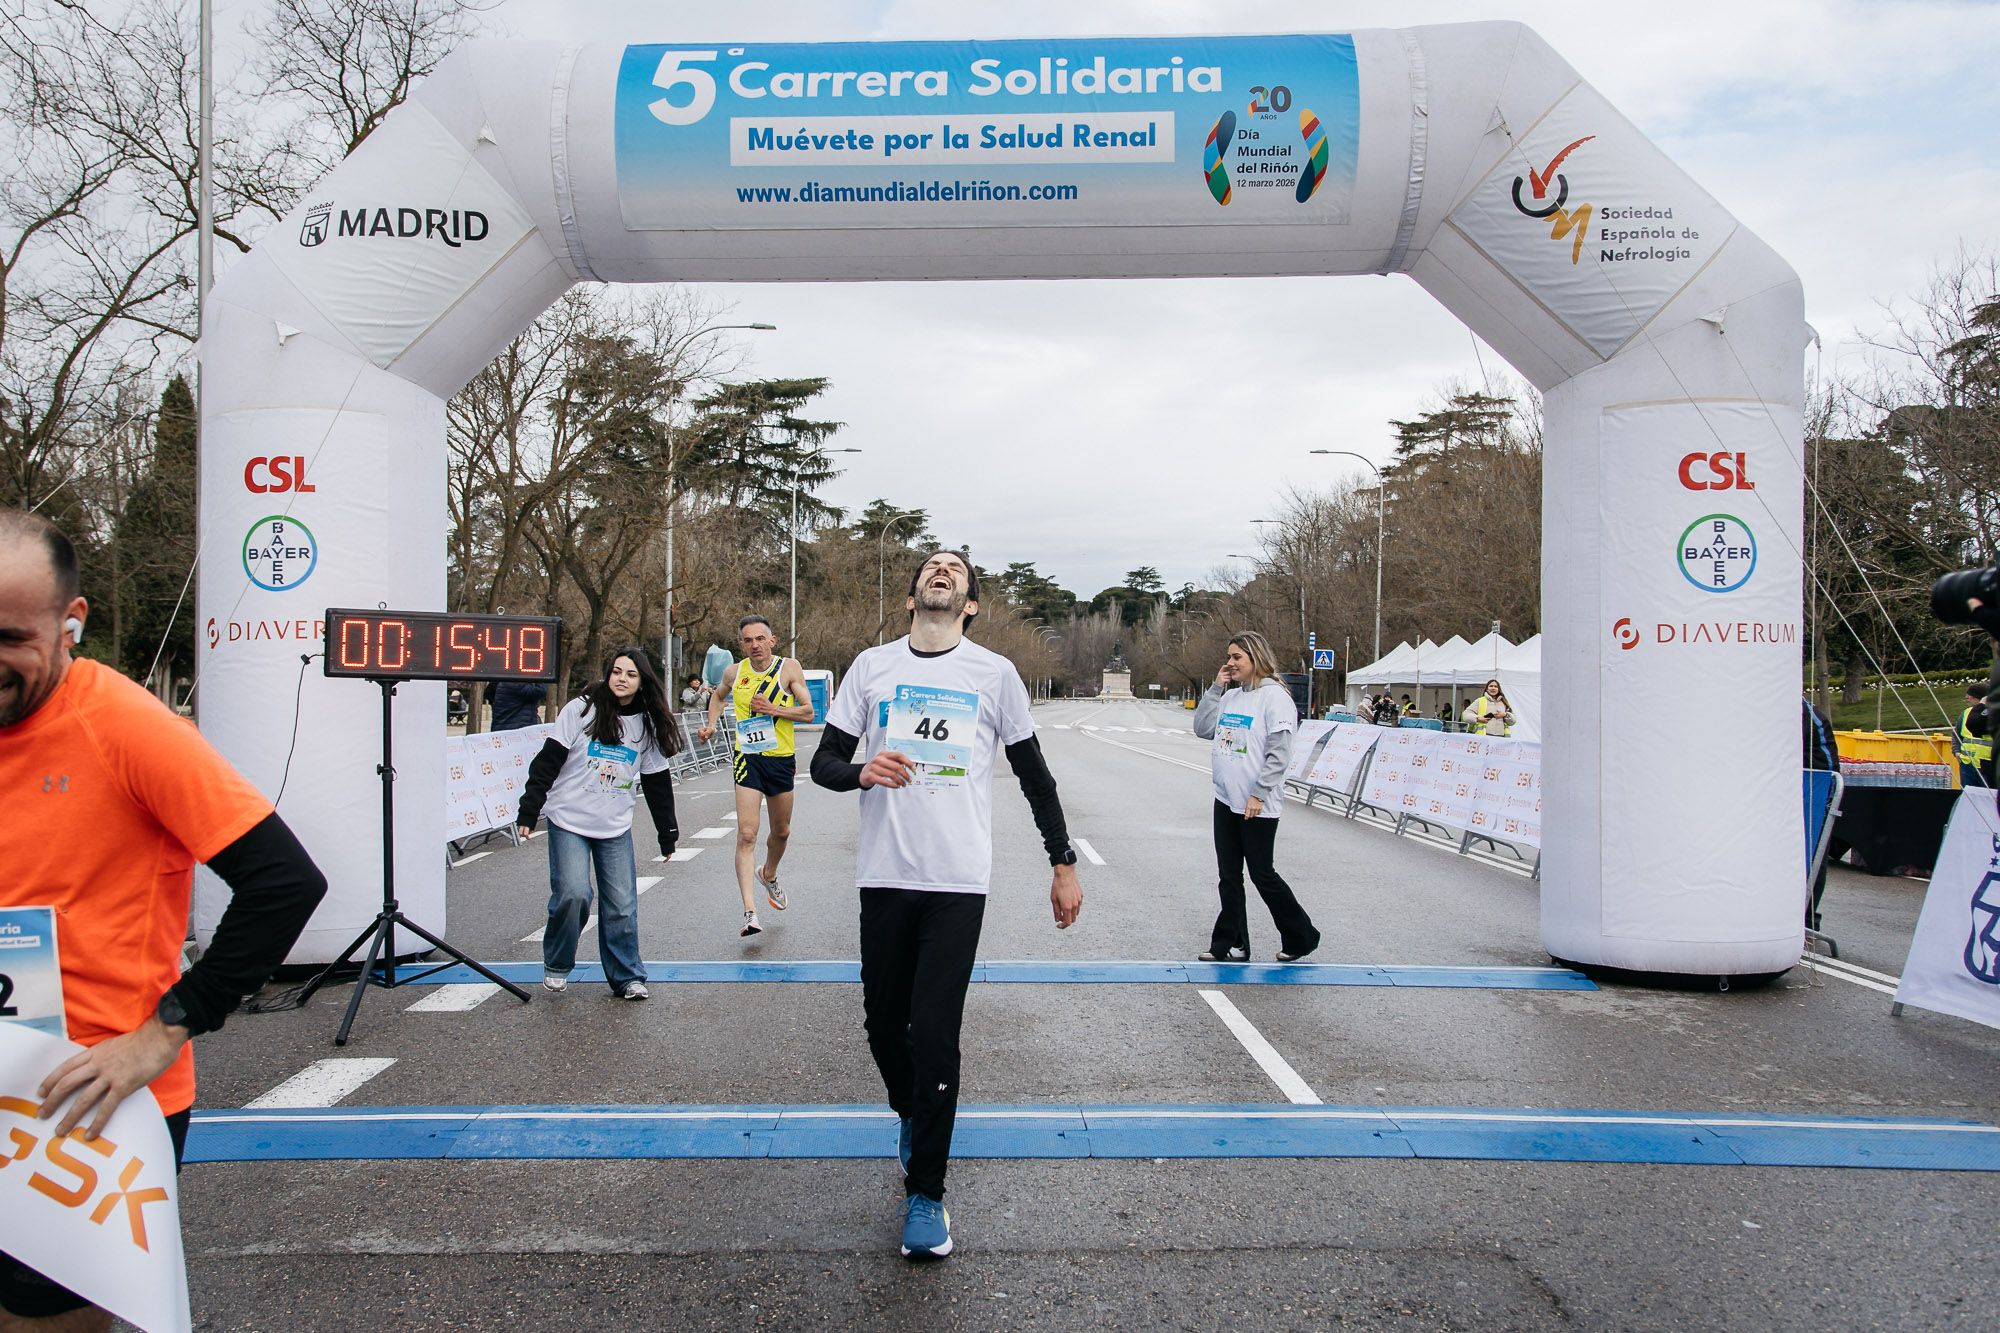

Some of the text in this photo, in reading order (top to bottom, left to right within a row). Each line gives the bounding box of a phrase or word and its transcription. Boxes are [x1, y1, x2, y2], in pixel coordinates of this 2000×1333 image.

[728, 61, 948, 99] Carrera
[967, 56, 1223, 97] Solidaria
[1248, 85, 1292, 118] 20
[748, 121, 1156, 156] Muévete por la Salud Renal
[1238, 129, 1260, 140] Día
[1237, 145, 1292, 157] Mundial
[1236, 161, 1298, 174] del Riñón
[737, 179, 1078, 203] www.diamundialdelriñon.com
[1236, 179, 1247, 188] 12
[1275, 178, 1296, 187] 2026
[1601, 206, 1673, 220] Sociedad
[338, 208, 489, 248] MADRID
[1601, 226, 1700, 243] Española de
[1601, 246, 1691, 262] Nefrología
[244, 455, 316, 493] CSL
[1678, 451, 1756, 491] CSL
[248, 547, 310, 560] BAYER
[271, 522, 284, 585] BAYER
[1685, 547, 1751, 560] BAYER
[1712, 520, 1726, 586] BAYER
[1657, 623, 1795, 643] DIAVERUM
[341, 620, 545, 673] 00:15:48
[746, 730, 766, 744] 311
[914, 717, 949, 741] 46
[1412, 753, 1429, 768] GSK
[1484, 767, 1501, 782] GSK
[0, 973, 18, 1016] 2
